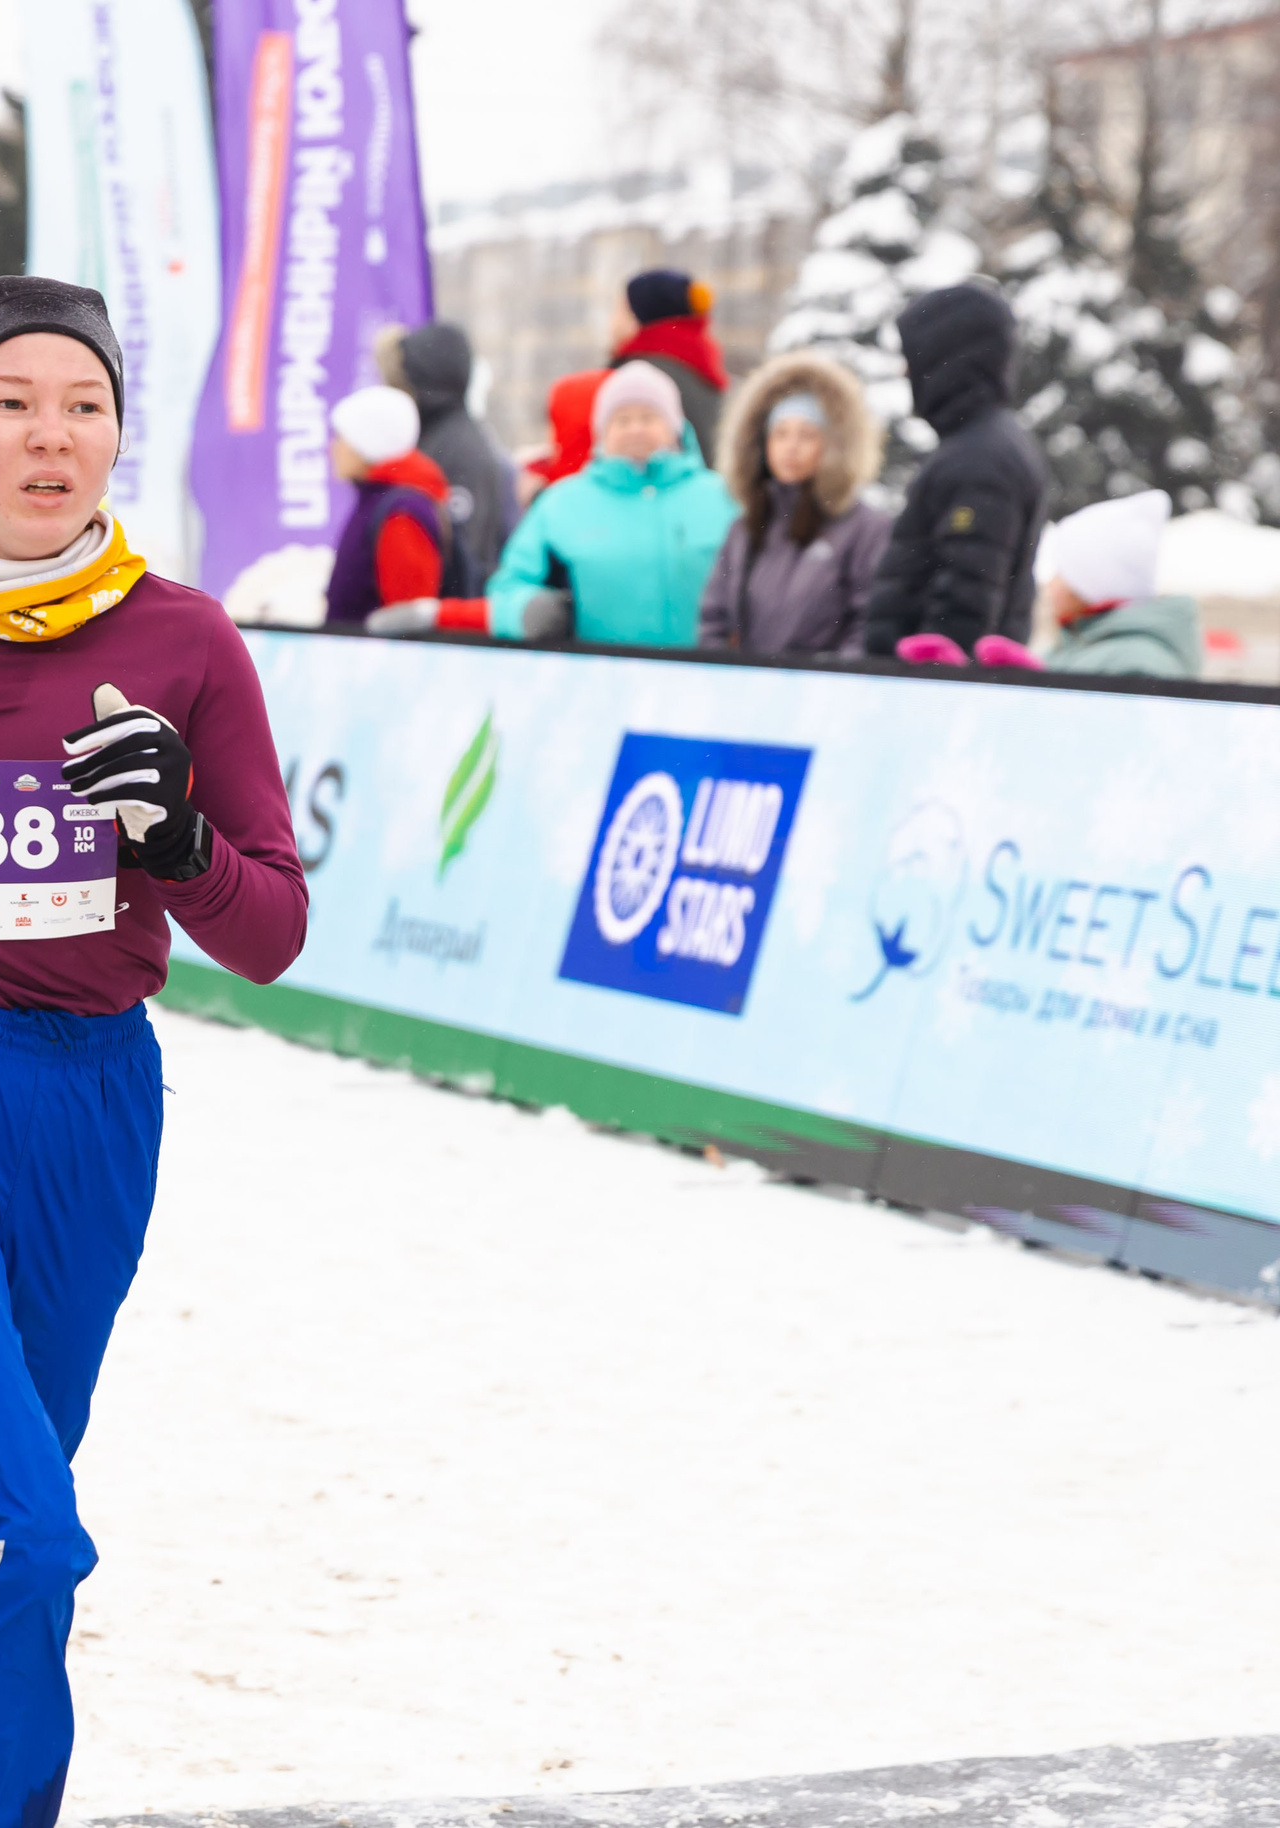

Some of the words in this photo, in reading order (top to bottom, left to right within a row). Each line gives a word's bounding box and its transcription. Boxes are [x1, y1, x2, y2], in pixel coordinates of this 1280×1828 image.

[69, 808, 100, 817] ИЖЕВСК
[681, 776, 783, 875] LUMO
[74, 826, 95, 841] 10
[74, 841, 95, 854] КМ
[656, 876, 755, 967] STARS
